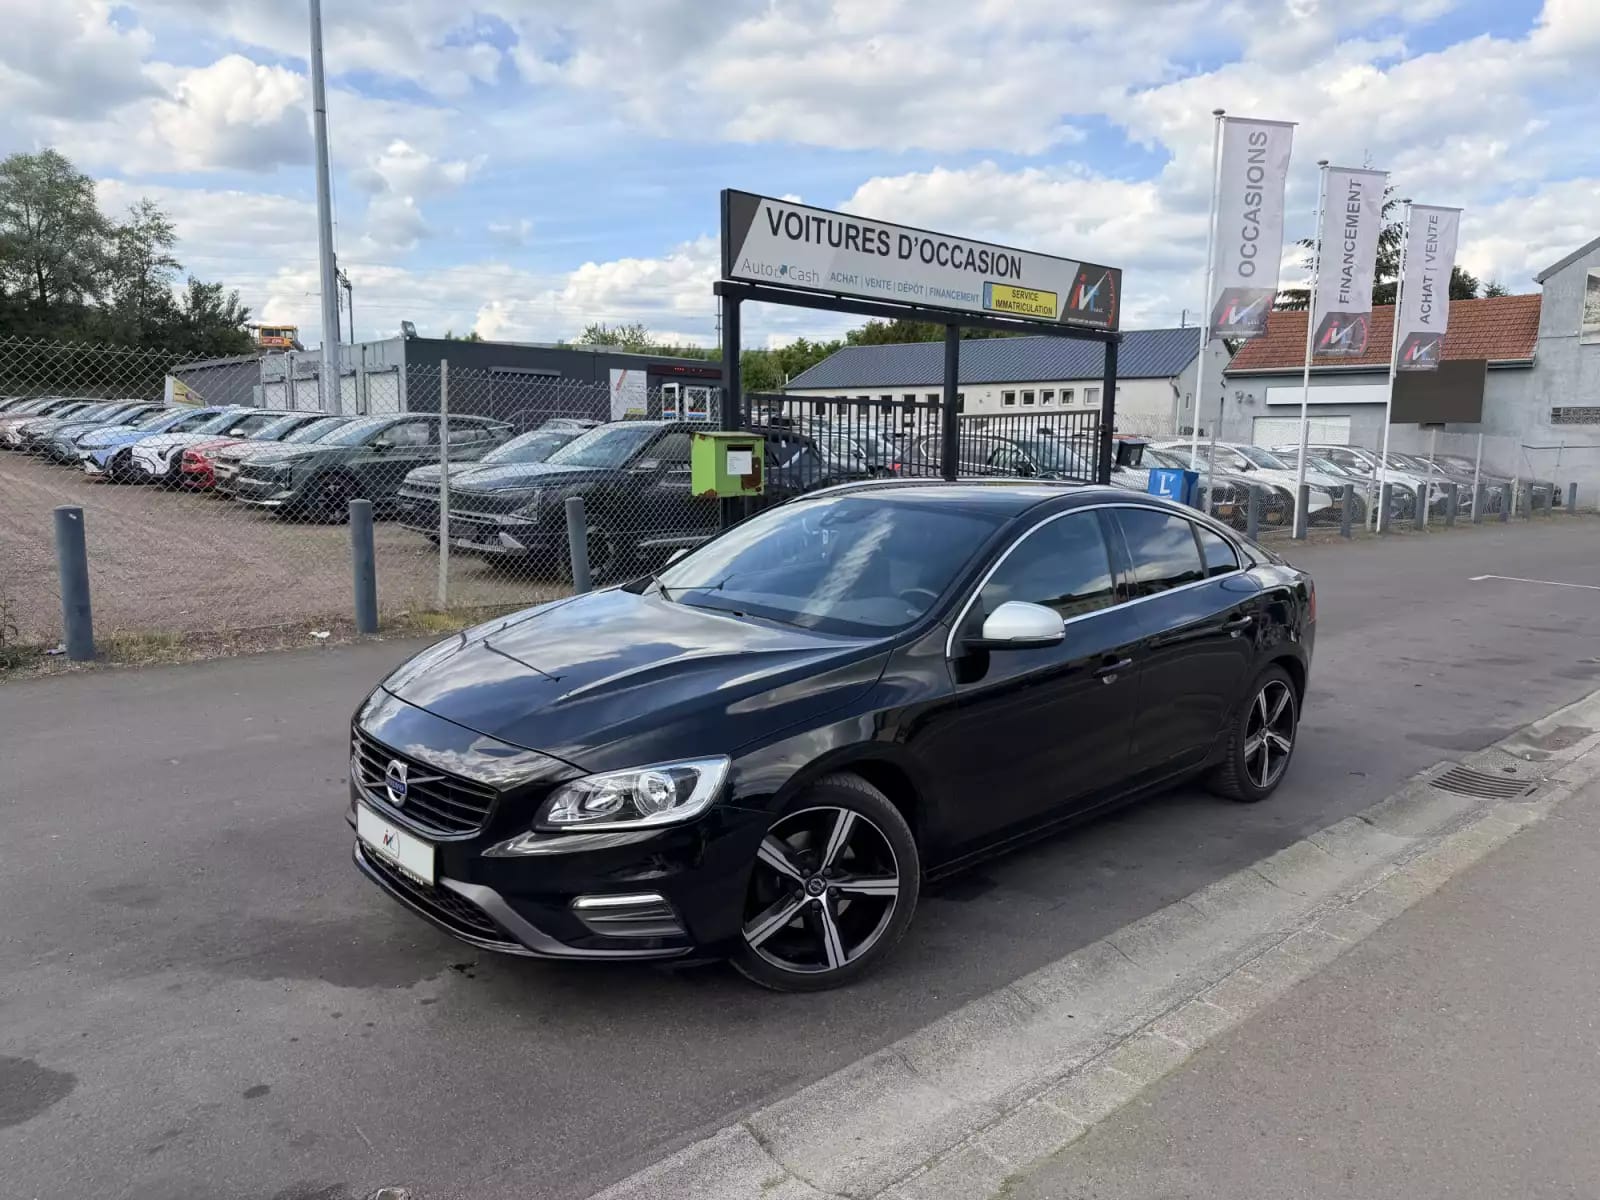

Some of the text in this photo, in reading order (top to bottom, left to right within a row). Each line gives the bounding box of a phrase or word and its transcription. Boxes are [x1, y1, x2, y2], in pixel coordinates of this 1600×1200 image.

[1238, 131, 1268, 278] OCCASIONS
[766, 206, 891, 257] VOITURES
[1338, 178, 1362, 304] FINANCEMENT
[830, 271, 859, 285] ACHAT
[865, 276, 892, 291] VENTE
[929, 287, 980, 304] FINANCEMENT
[1011, 289, 1039, 302] SERVICE
[1420, 215, 1439, 325] ACHAT VENTE
[995, 299, 1053, 315] IMMATRICULATION
